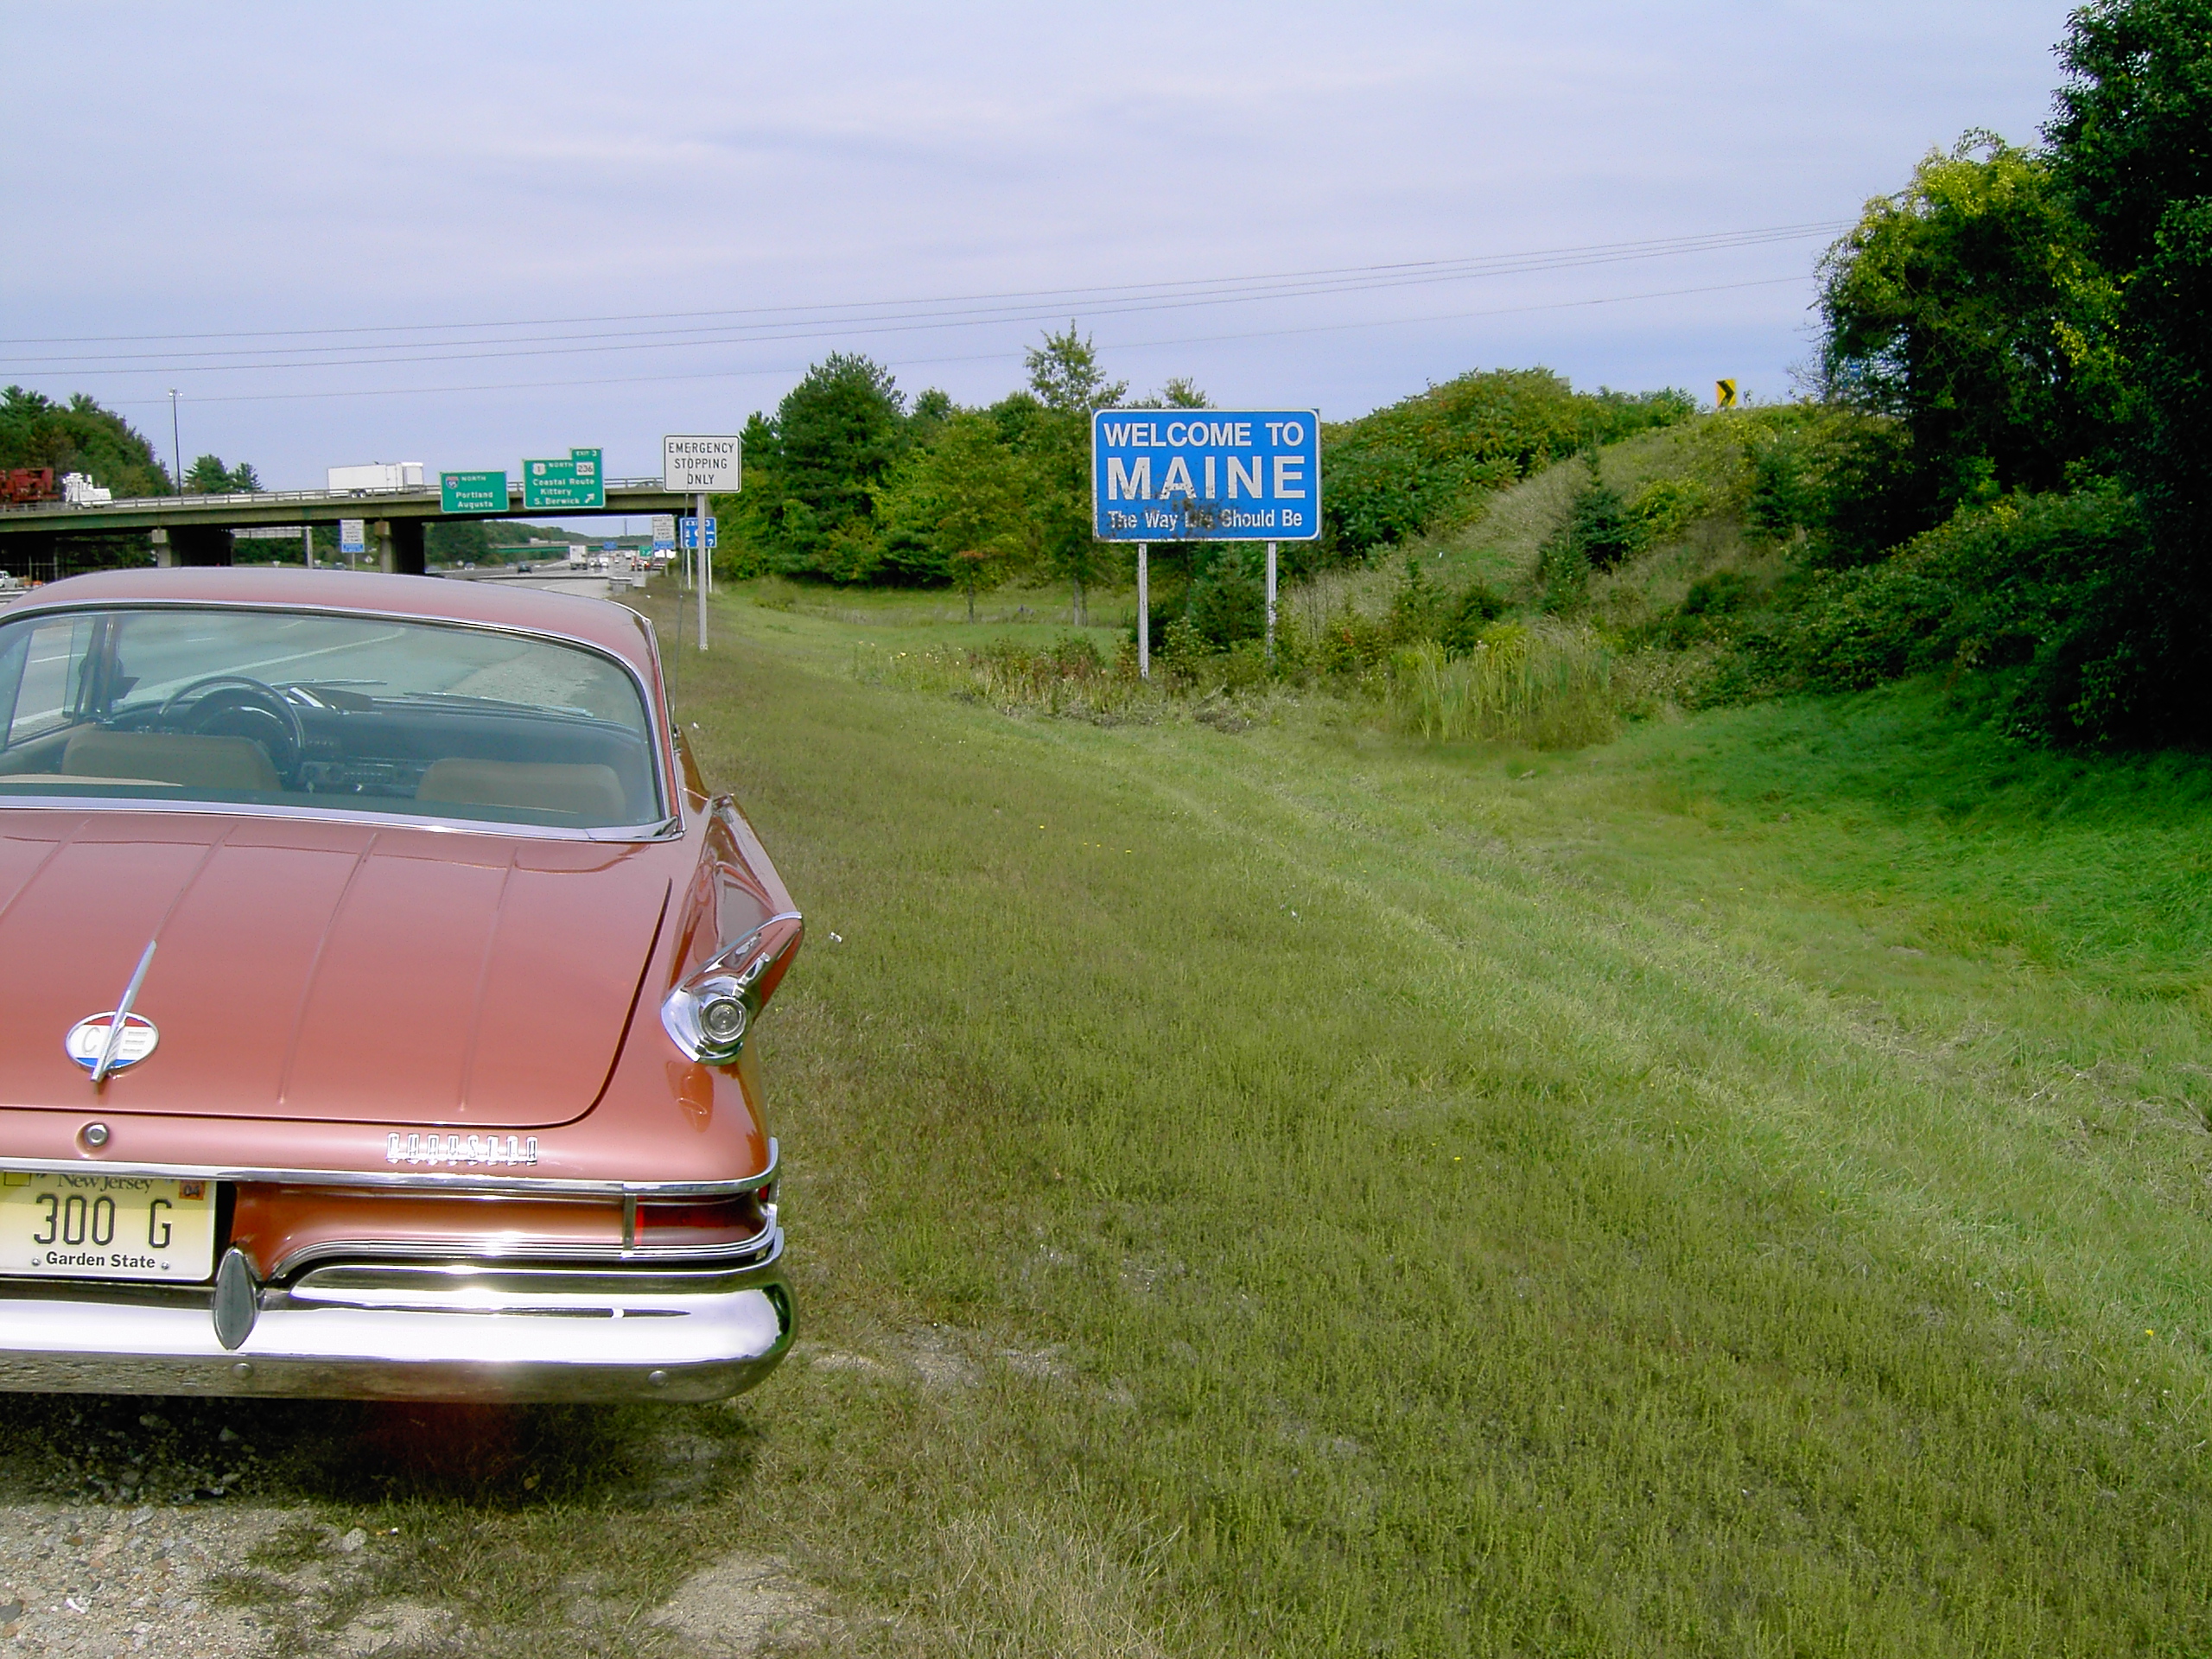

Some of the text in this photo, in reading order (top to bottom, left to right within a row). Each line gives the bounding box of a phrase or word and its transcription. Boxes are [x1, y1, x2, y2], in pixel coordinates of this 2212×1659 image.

[1103, 421, 1304, 447] WELCOME TO
[669, 442, 734, 454] EMERGENCY
[577, 464, 593, 473] 236
[674, 458, 728, 469] STOPPING
[687, 474, 715, 485] ONLY
[1107, 455, 1306, 500] MAINE
[457, 500, 493, 509] Augusta
[1108, 510, 1138, 529] The
[1145, 510, 1178, 531] Way
[1221, 508, 1274, 528] Should
[1281, 508, 1302, 527] Be
[58, 1173, 155, 1193] New Jersey
[34, 1193, 172, 1249] 300 G
[46, 1250, 156, 1268] Garden State
